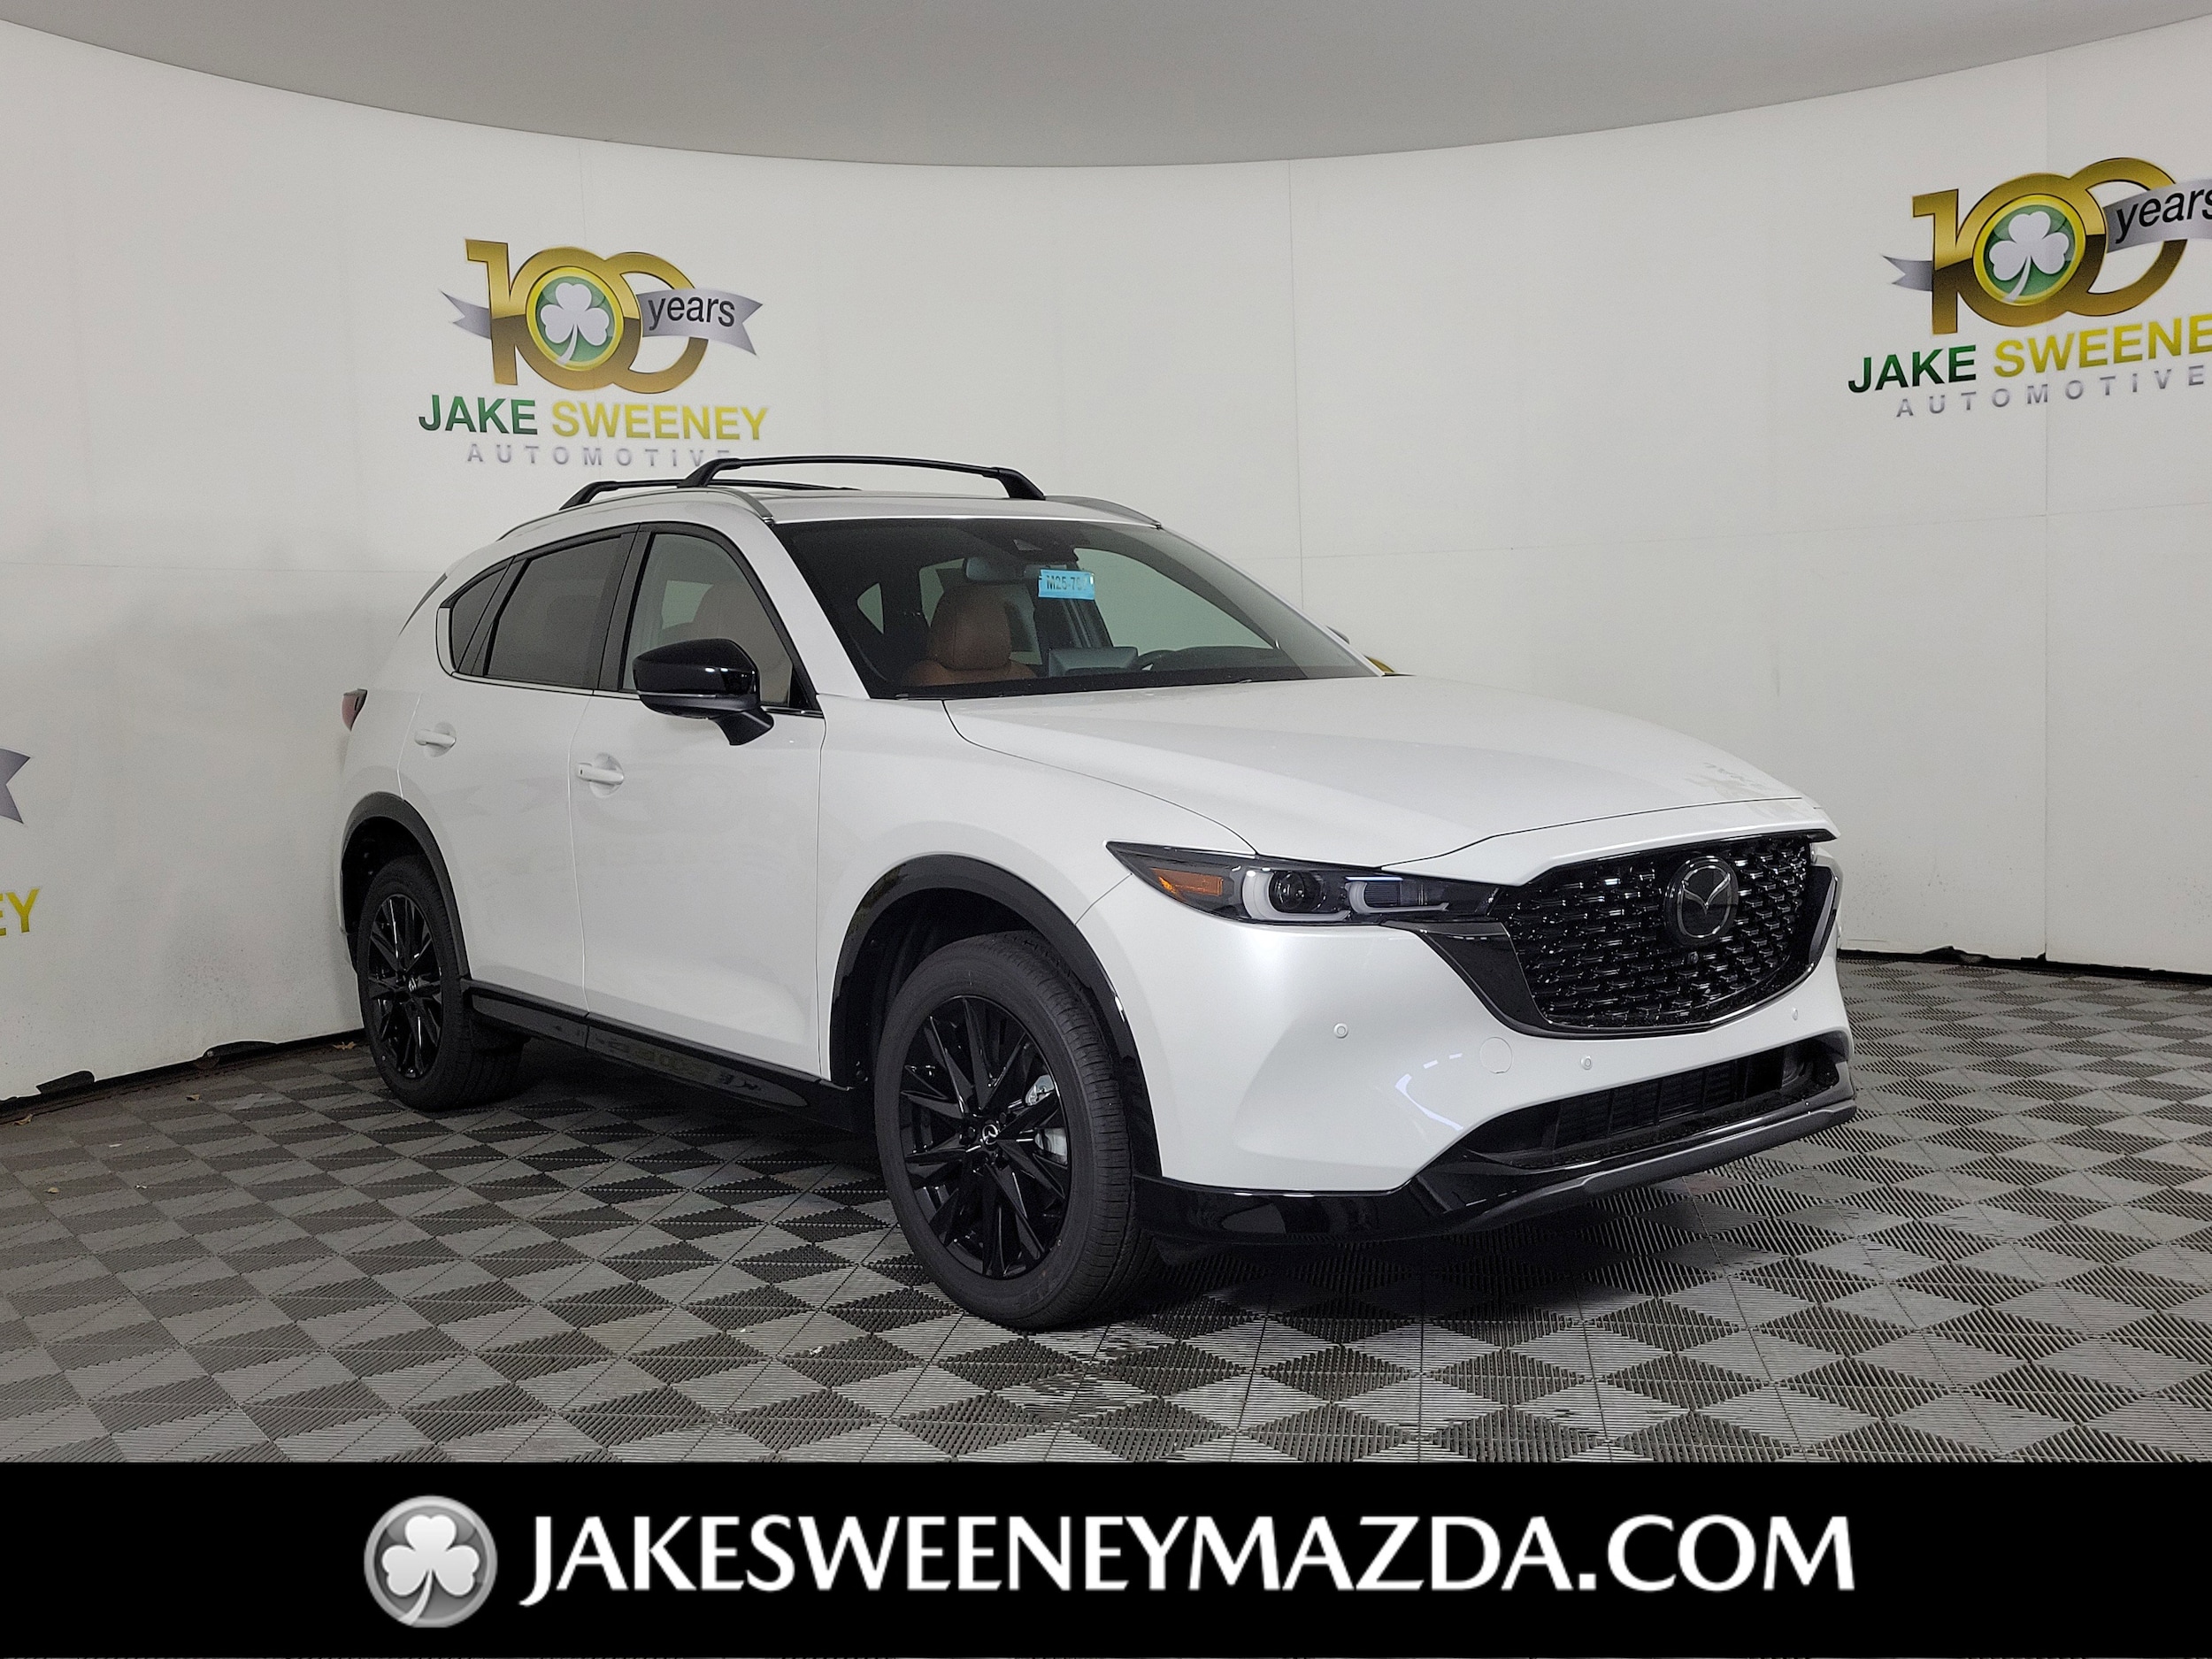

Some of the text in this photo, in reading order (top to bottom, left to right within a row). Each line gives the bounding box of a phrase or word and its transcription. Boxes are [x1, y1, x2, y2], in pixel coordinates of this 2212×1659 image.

[2115, 187, 2212, 243] years
[648, 296, 736, 331] years
[1847, 344, 1977, 394] JAKE
[1896, 365, 2205, 419] AUTOMOTIVE
[419, 394, 769, 440] JAKE SWEENEY
